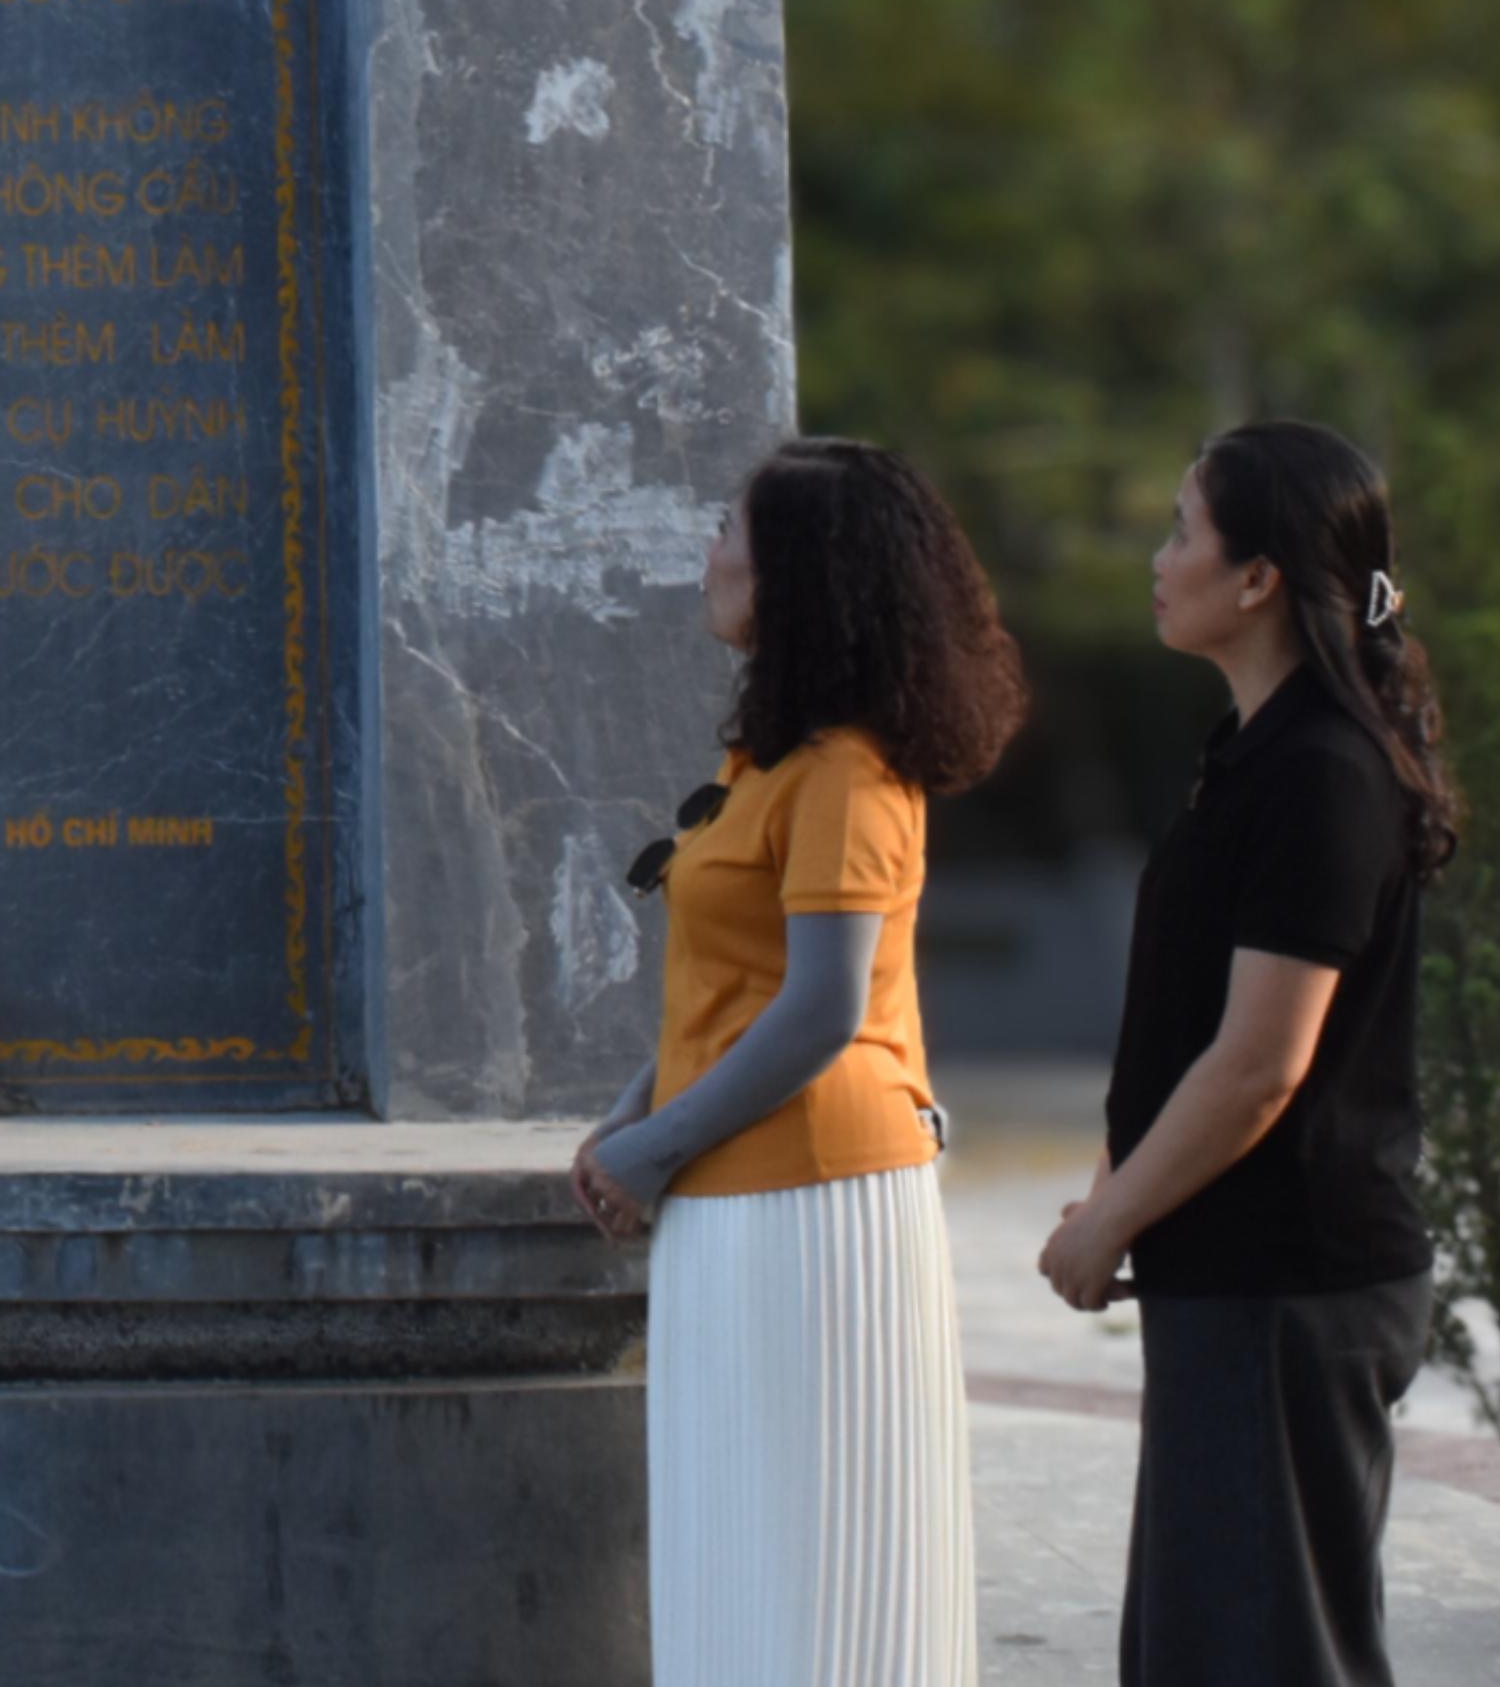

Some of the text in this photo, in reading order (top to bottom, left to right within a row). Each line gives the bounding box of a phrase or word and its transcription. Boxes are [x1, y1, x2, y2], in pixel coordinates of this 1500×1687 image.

[22, 234, 136, 289] THÈM
[151, 235, 244, 288] LÀM
[1, 310, 115, 366] THÈM
[152, 309, 245, 364] LÀM
[8, 396, 72, 449] CỤ
[15, 474, 121, 520] CHO
[148, 465, 247, 519] DÂN
[107, 548, 246, 605] ĐƯỢC
[127, 817, 214, 848] MINH
